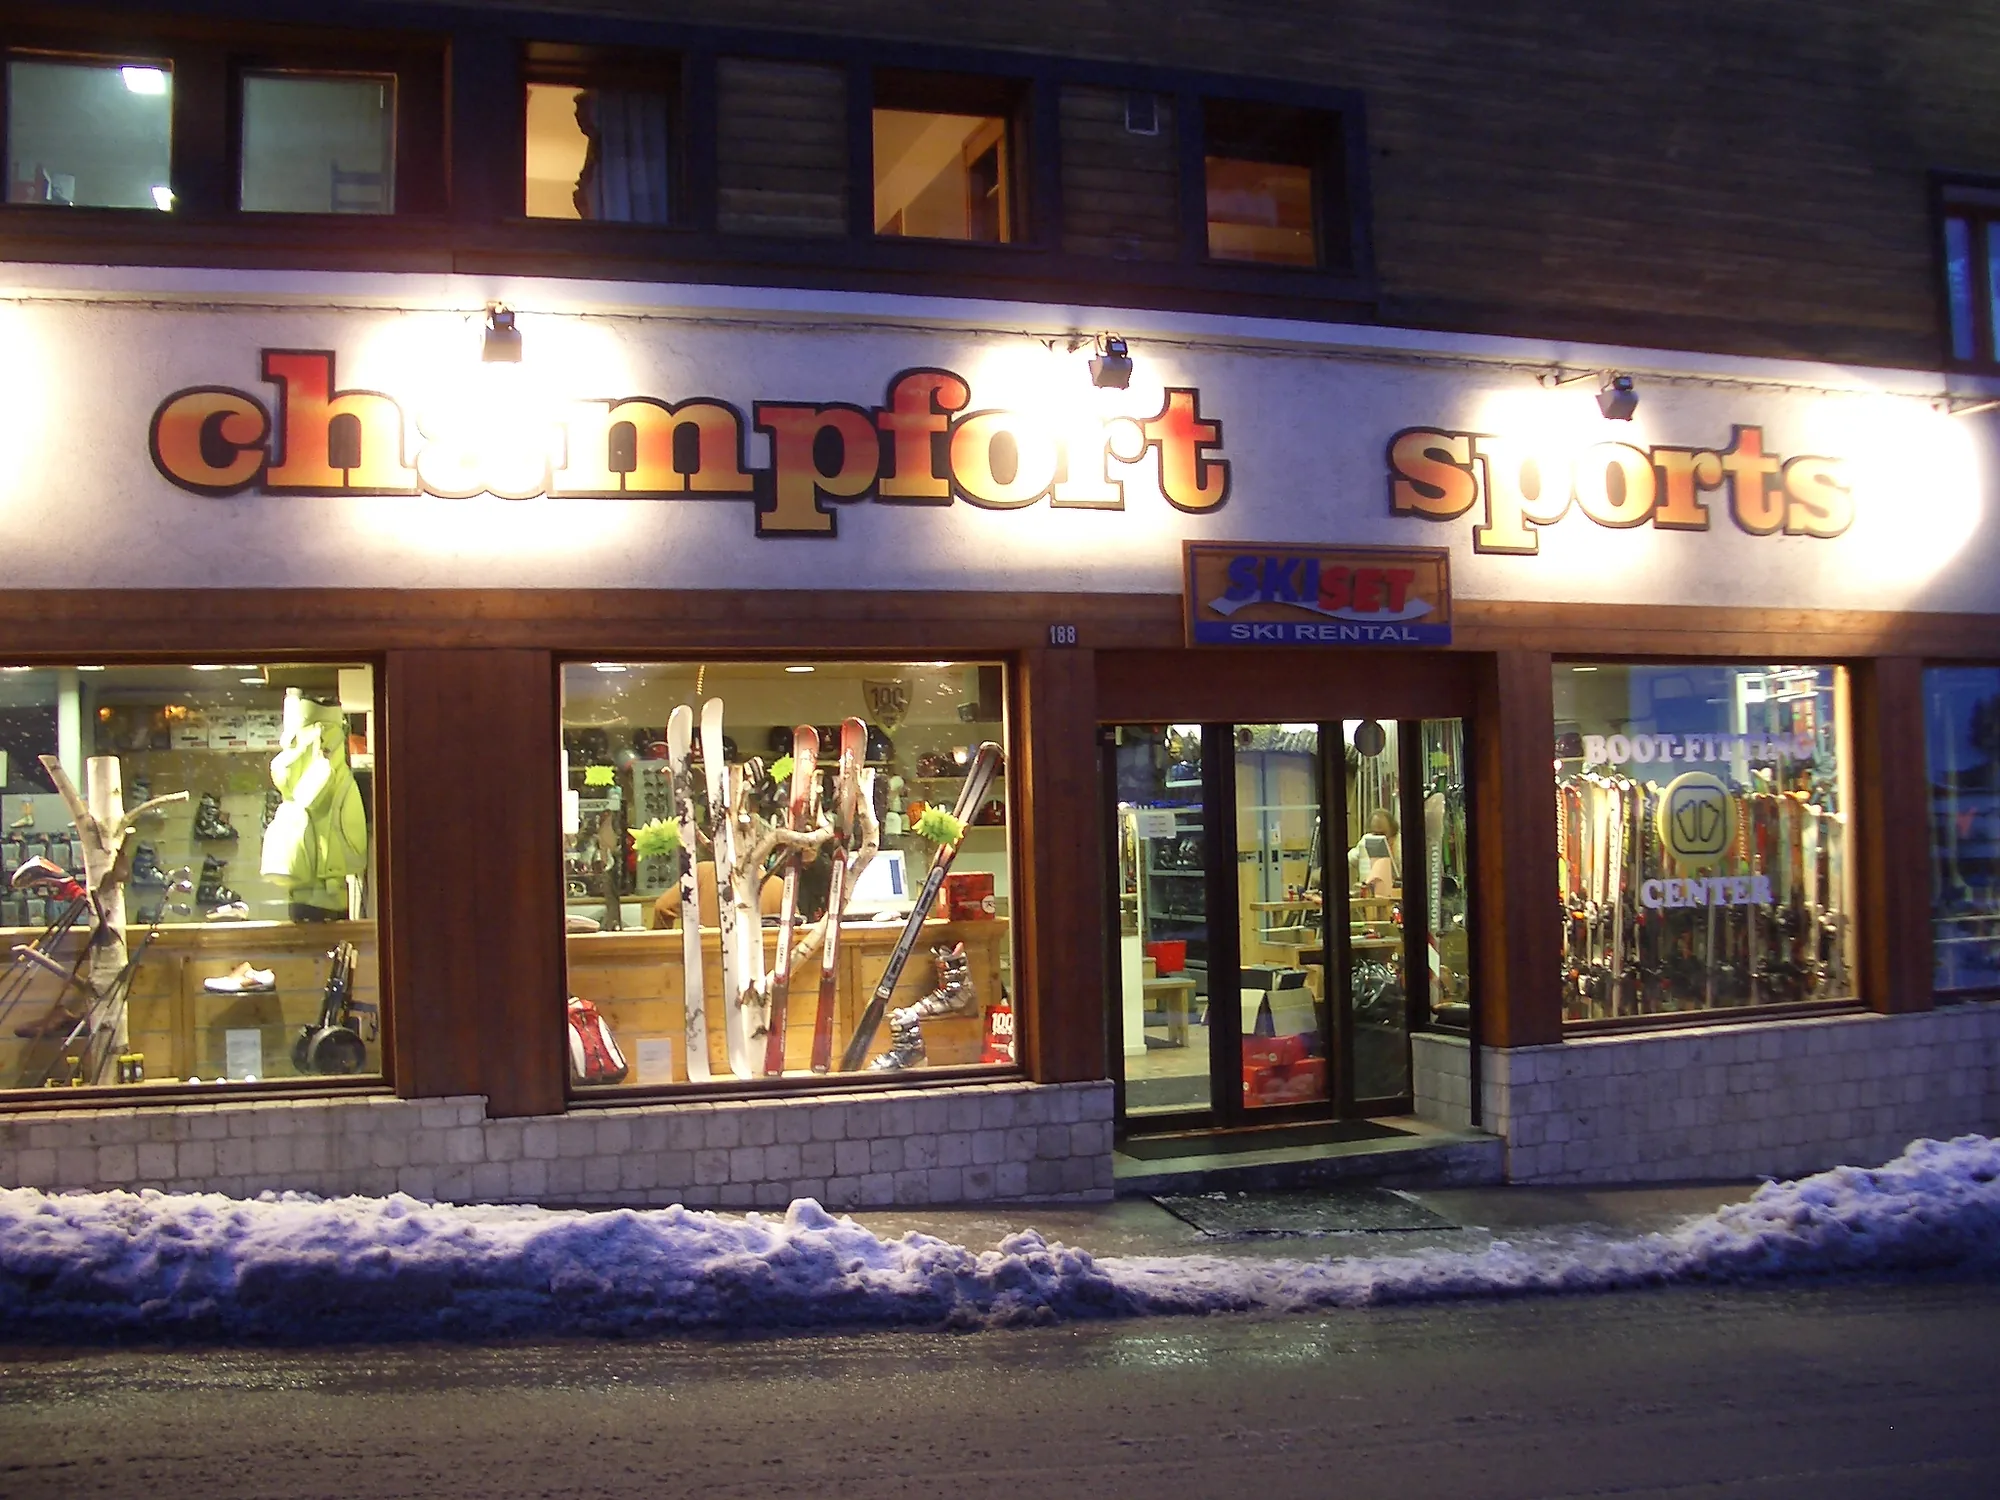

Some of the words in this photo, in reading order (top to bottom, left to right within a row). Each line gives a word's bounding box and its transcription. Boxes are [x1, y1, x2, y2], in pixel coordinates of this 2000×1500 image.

[1388, 423, 1857, 556] sports
[1050, 624, 1076, 645] 188
[1231, 623, 1286, 640] SKI
[1295, 624, 1419, 641] RENTAL
[1582, 732, 1815, 765] BOOT-FITTING
[1640, 876, 1774, 909] CENTER
